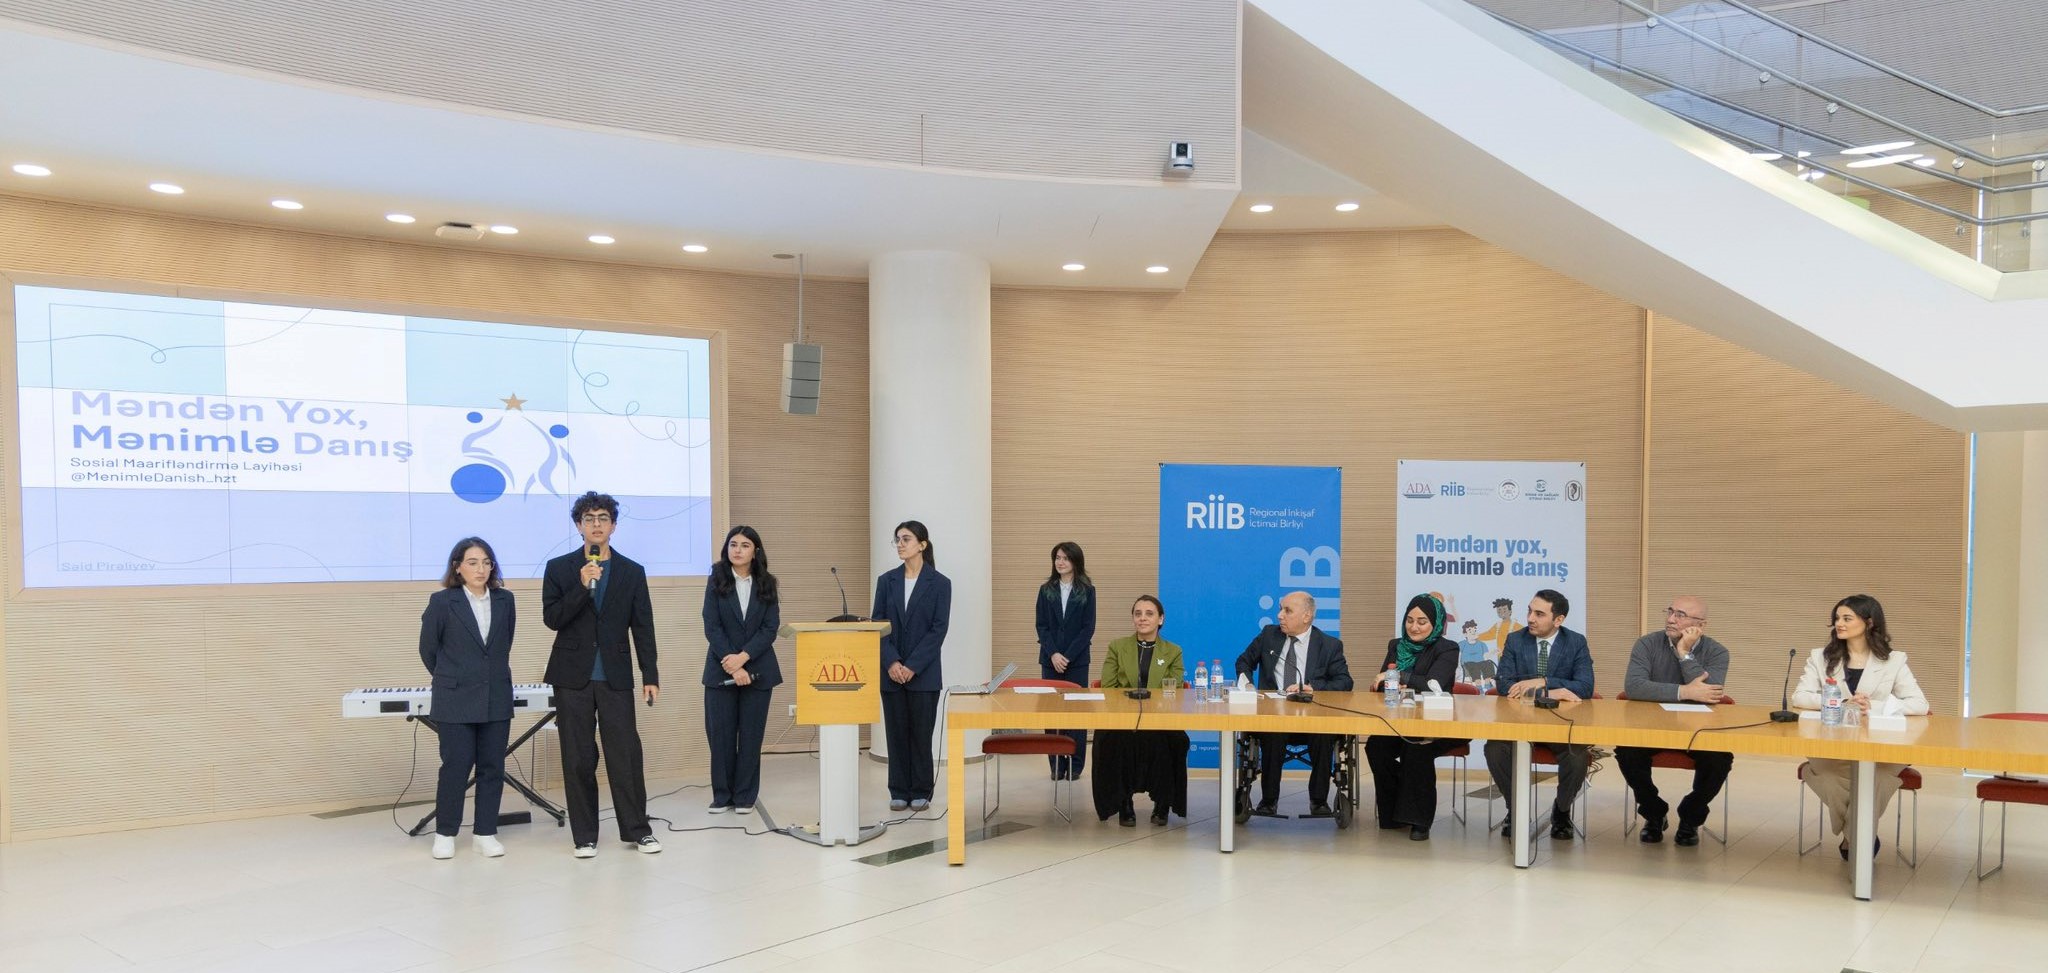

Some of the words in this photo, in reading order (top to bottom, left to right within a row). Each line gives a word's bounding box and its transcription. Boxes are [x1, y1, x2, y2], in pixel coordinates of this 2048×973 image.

[72, 391, 263, 421] Məndən
[277, 400, 367, 430] Yox,
[73, 424, 279, 453] Mənimlə
[294, 432, 413, 462] Danış
[70, 457, 119, 468] Sosial
[123, 458, 239, 470] Maarifləndirmə
[243, 461, 303, 472] Layihəsi
[71, 471, 237, 483] @MenimleDanish_hzt
[1406, 482, 1432, 494] ADA
[1249, 507, 1287, 518] Regional
[1416, 533, 1498, 553] Məndən
[1505, 538, 1548, 558] yox,
[1415, 556, 1505, 576] Mənimlə
[1511, 557, 1569, 583] danış
[816, 664, 860, 682] ADA
